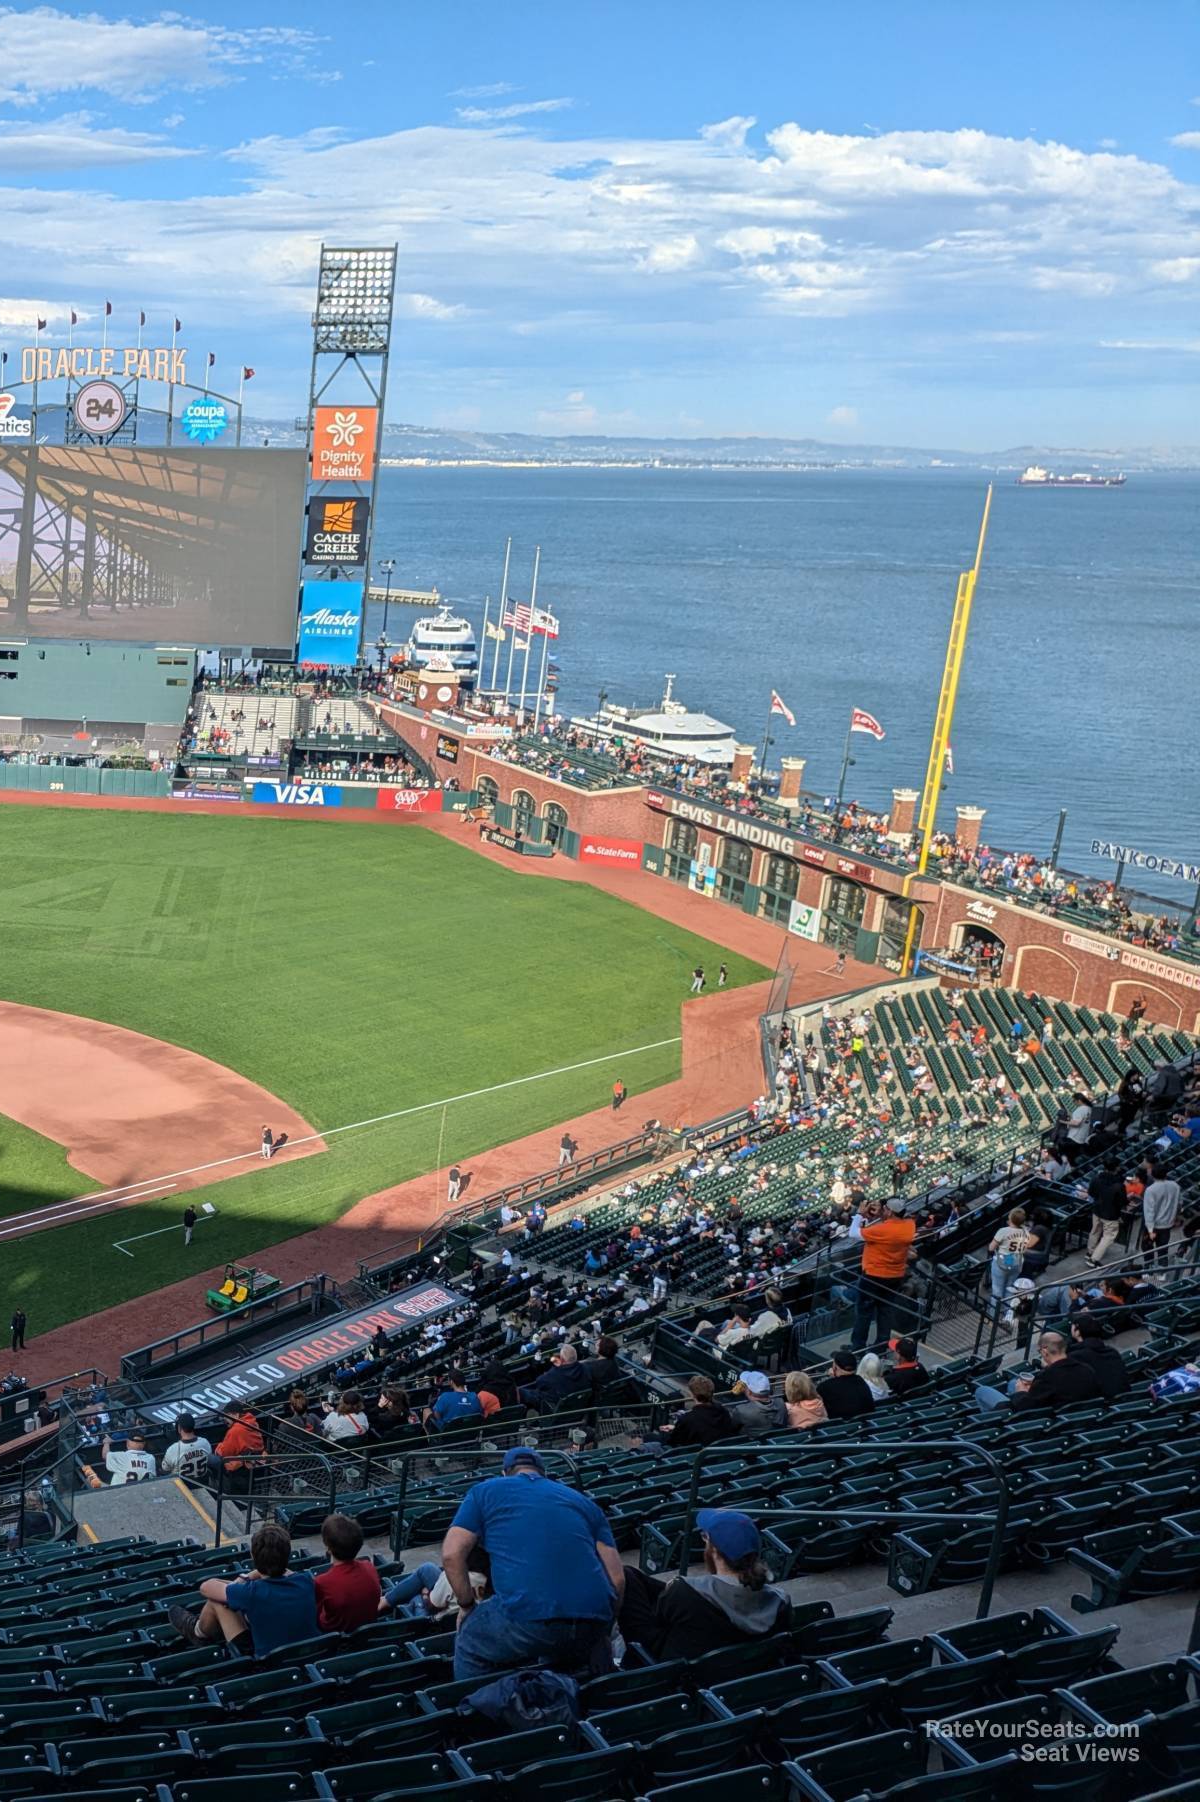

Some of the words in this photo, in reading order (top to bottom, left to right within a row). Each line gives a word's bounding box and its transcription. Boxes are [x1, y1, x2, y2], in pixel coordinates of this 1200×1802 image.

[21, 348, 114, 384] ORACLE
[122, 348, 187, 386] PARK
[85, 398, 119, 422] 24
[186, 406, 225, 420] coupa
[320, 449, 365, 466] Dignity
[321, 465, 362, 477] Health
[313, 533, 361, 543] CACHE
[313, 543, 358, 554] CREEK
[302, 608, 360, 627] Alaska
[304, 627, 353, 635] AIRLINES
[304, 771, 342, 779] WELCOME
[50, 782, 64, 791] 391
[271, 784, 325, 805] VISA
[397, 791, 418, 804] AAA
[717, 814, 795, 854] LANDING
[1091, 840, 1139, 865] BANK
[1145, 855, 1170, 873] OF
[966, 900, 998, 919] Alaska
[885, 958, 902, 971] 309
[152, 1375, 259, 1424] WELCOME
[246, 1363, 286, 1384] TO
[276, 1331, 359, 1371] ORACLE
[345, 1310, 407, 1340] PARK
[180, 1457, 207, 1478] 25
